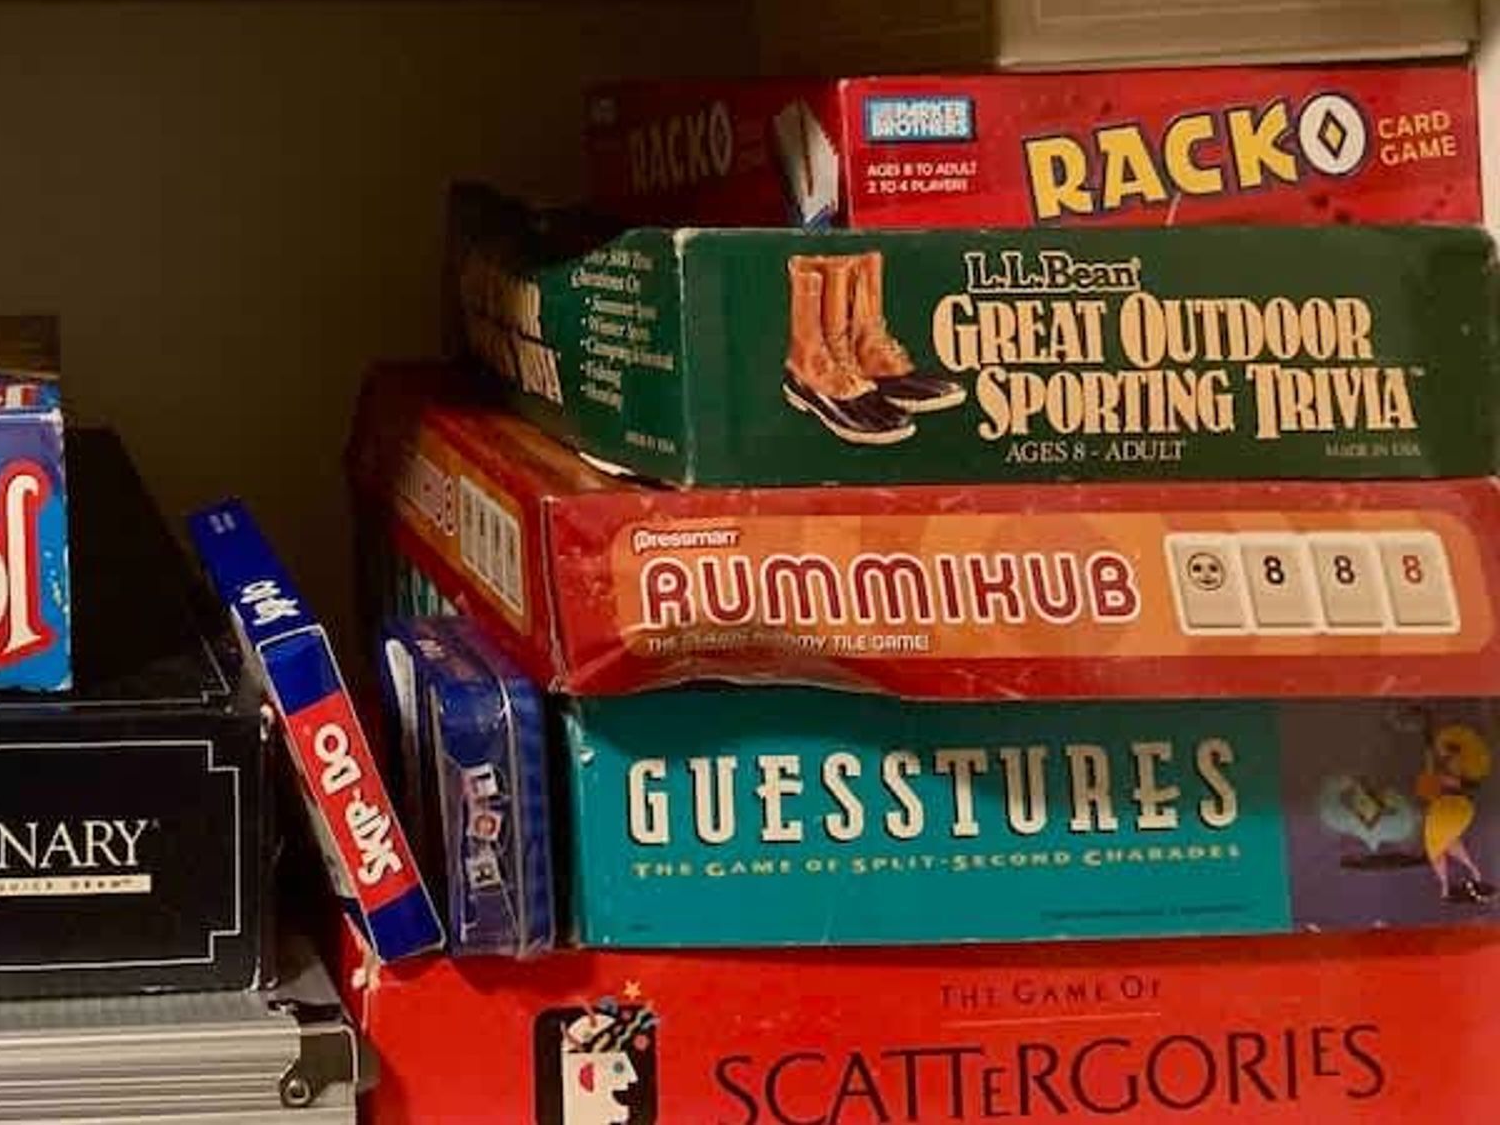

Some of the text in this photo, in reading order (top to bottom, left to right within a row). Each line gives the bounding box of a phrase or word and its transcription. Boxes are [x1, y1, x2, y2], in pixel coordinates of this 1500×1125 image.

[1377, 111, 1451, 141] CARD
[1022, 90, 1370, 222] RACKO
[1378, 131, 1458, 167] GAME
[916, 162, 934, 176] TO
[932, 294, 1373, 371] GREAT OUTDOOR
[975, 363, 1418, 442] SPORTING TRIVIA
[1005, 440, 1185, 462] AGES 8 ADULT
[1264, 553, 1424, 587] 8 8 8
[640, 552, 1143, 630] RUMMIKUB
[832, 634, 865, 651] TILE
[627, 737, 1243, 847] GUESSTURES
[632, 843, 1242, 879] THE GAME OF SPLIT-SECOND CHARADES
[939, 983, 999, 1012] THE
[1011, 977, 1105, 1011] GAME
[710, 1022, 1390, 1125] SCATTERGORIES
